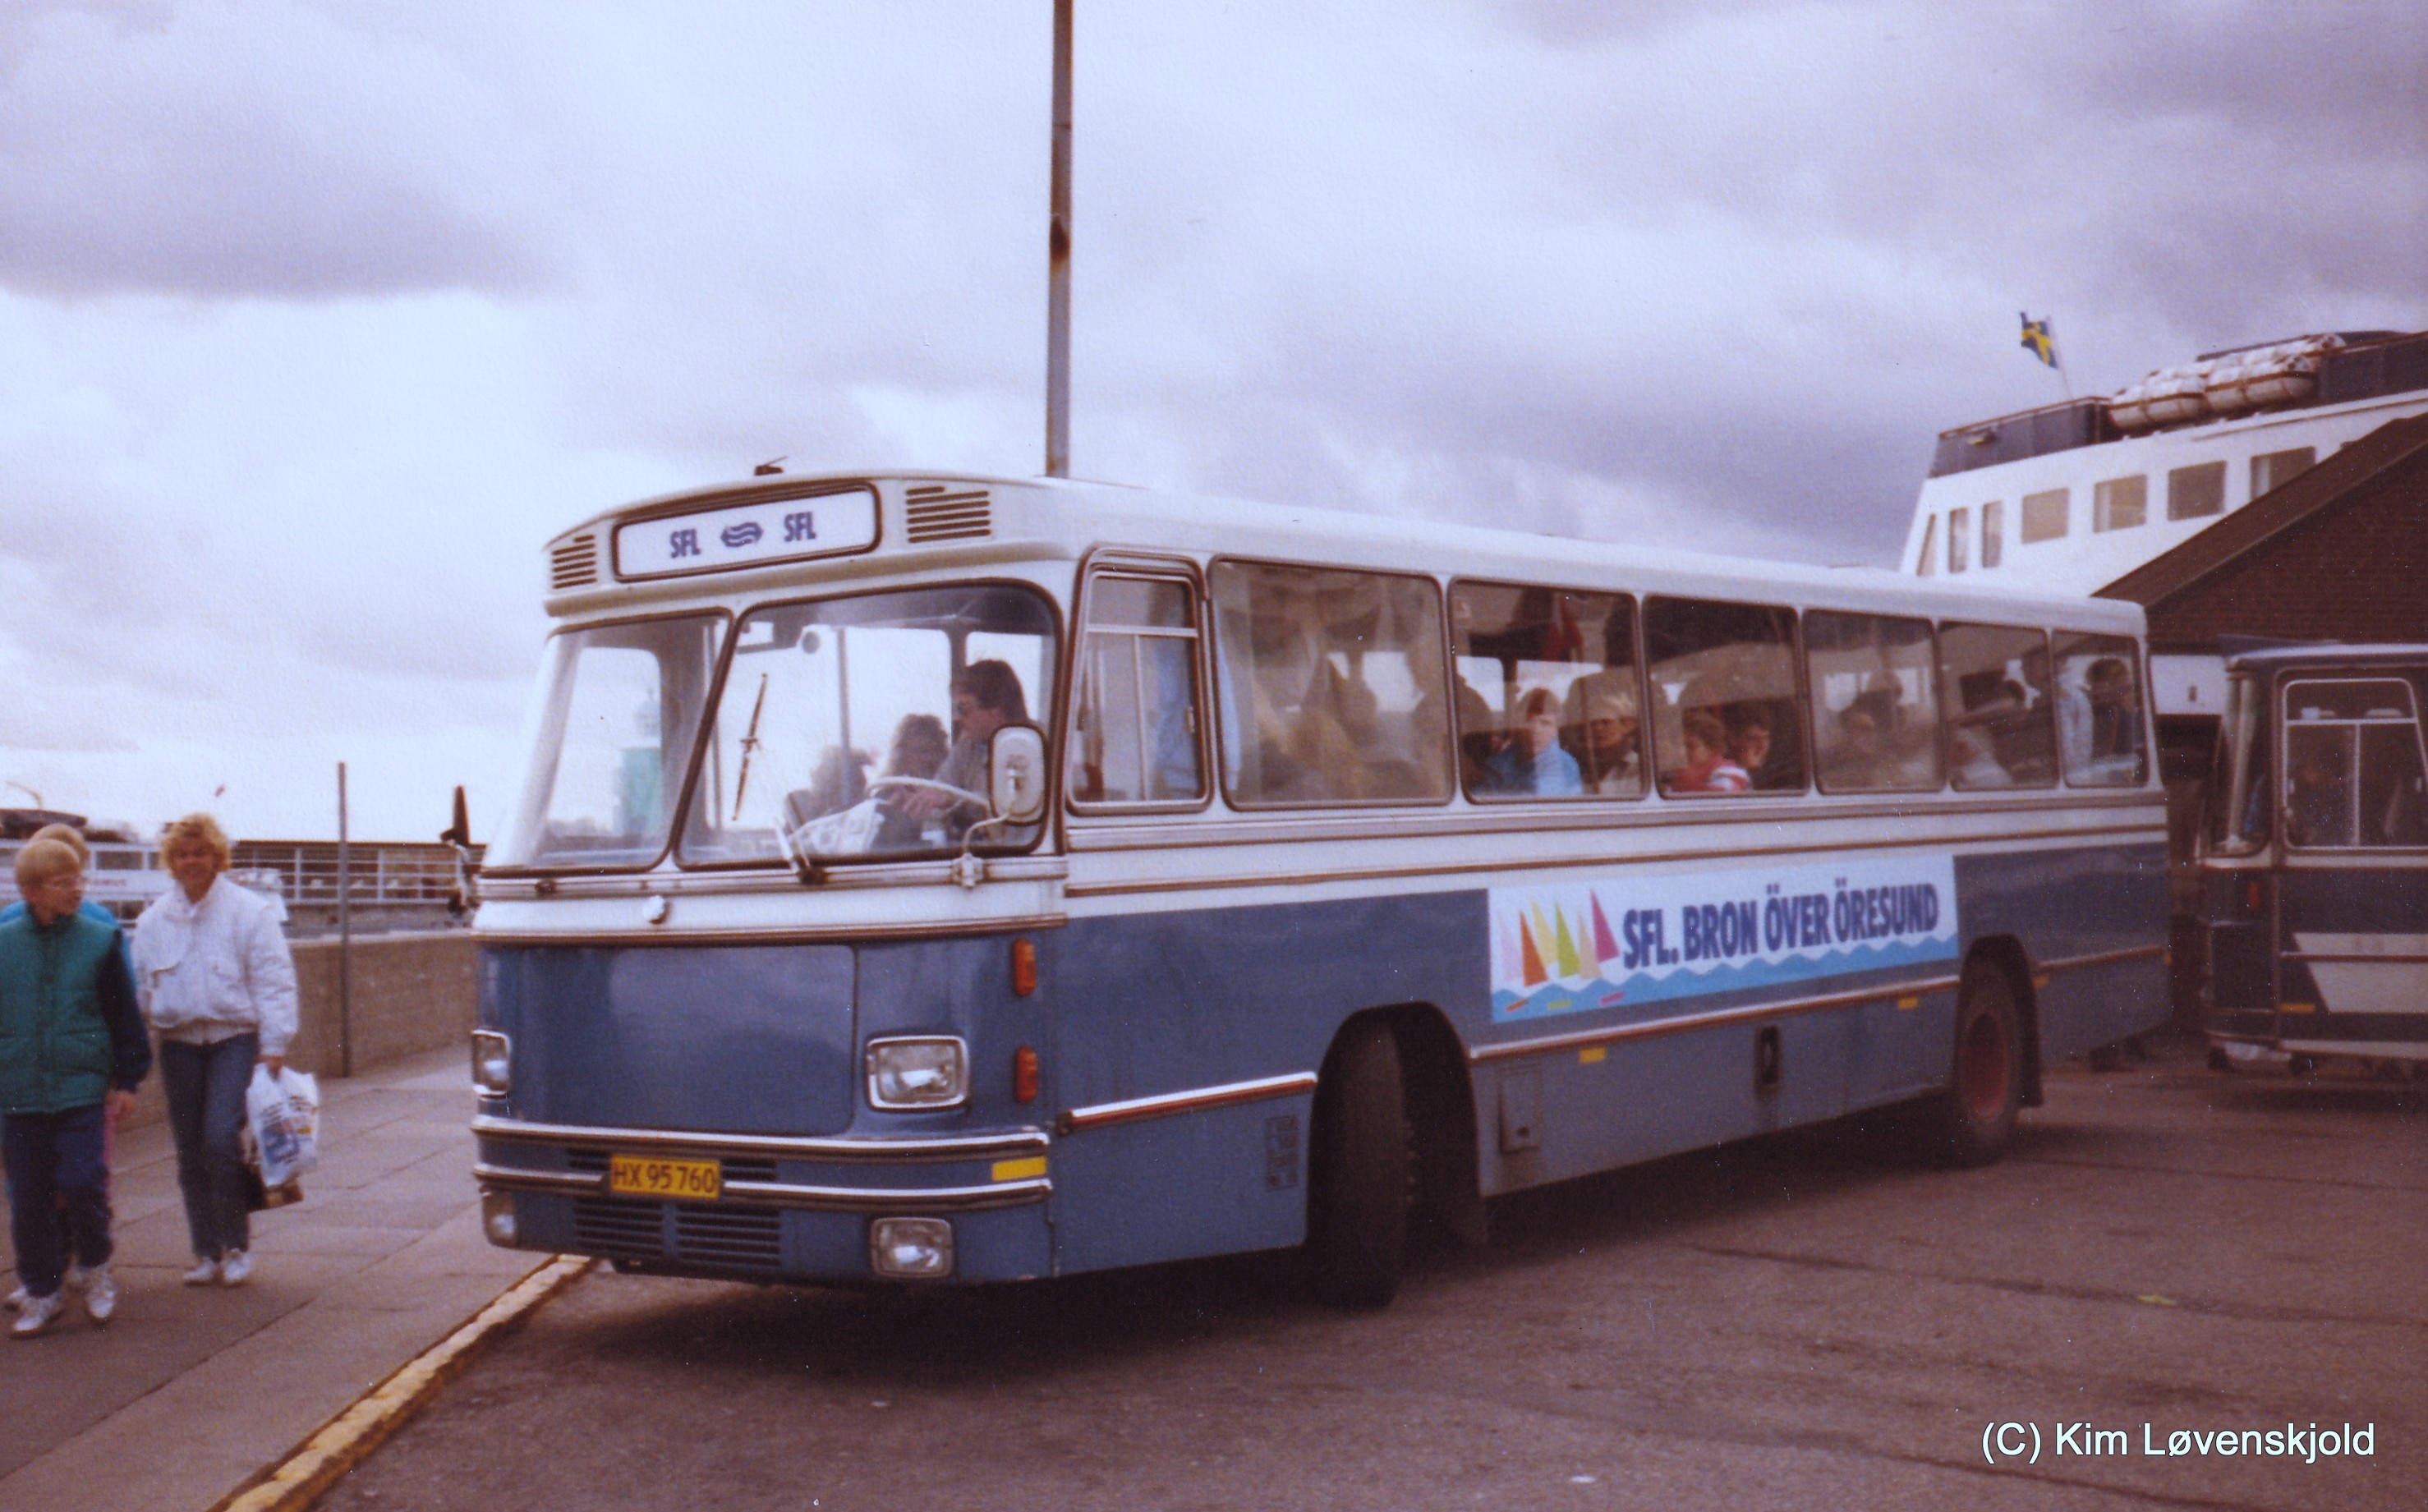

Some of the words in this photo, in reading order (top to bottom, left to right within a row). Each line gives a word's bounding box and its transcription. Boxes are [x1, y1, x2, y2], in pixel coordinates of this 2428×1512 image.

[669, 528, 701, 558] SFL
[783, 511, 817, 543] SFL
[1622, 908, 1679, 970] SFL.
[1682, 900, 1759, 962] BRON
[1764, 884, 1831, 952] ÖVER
[1833, 878, 1939, 944] ÖRESUND
